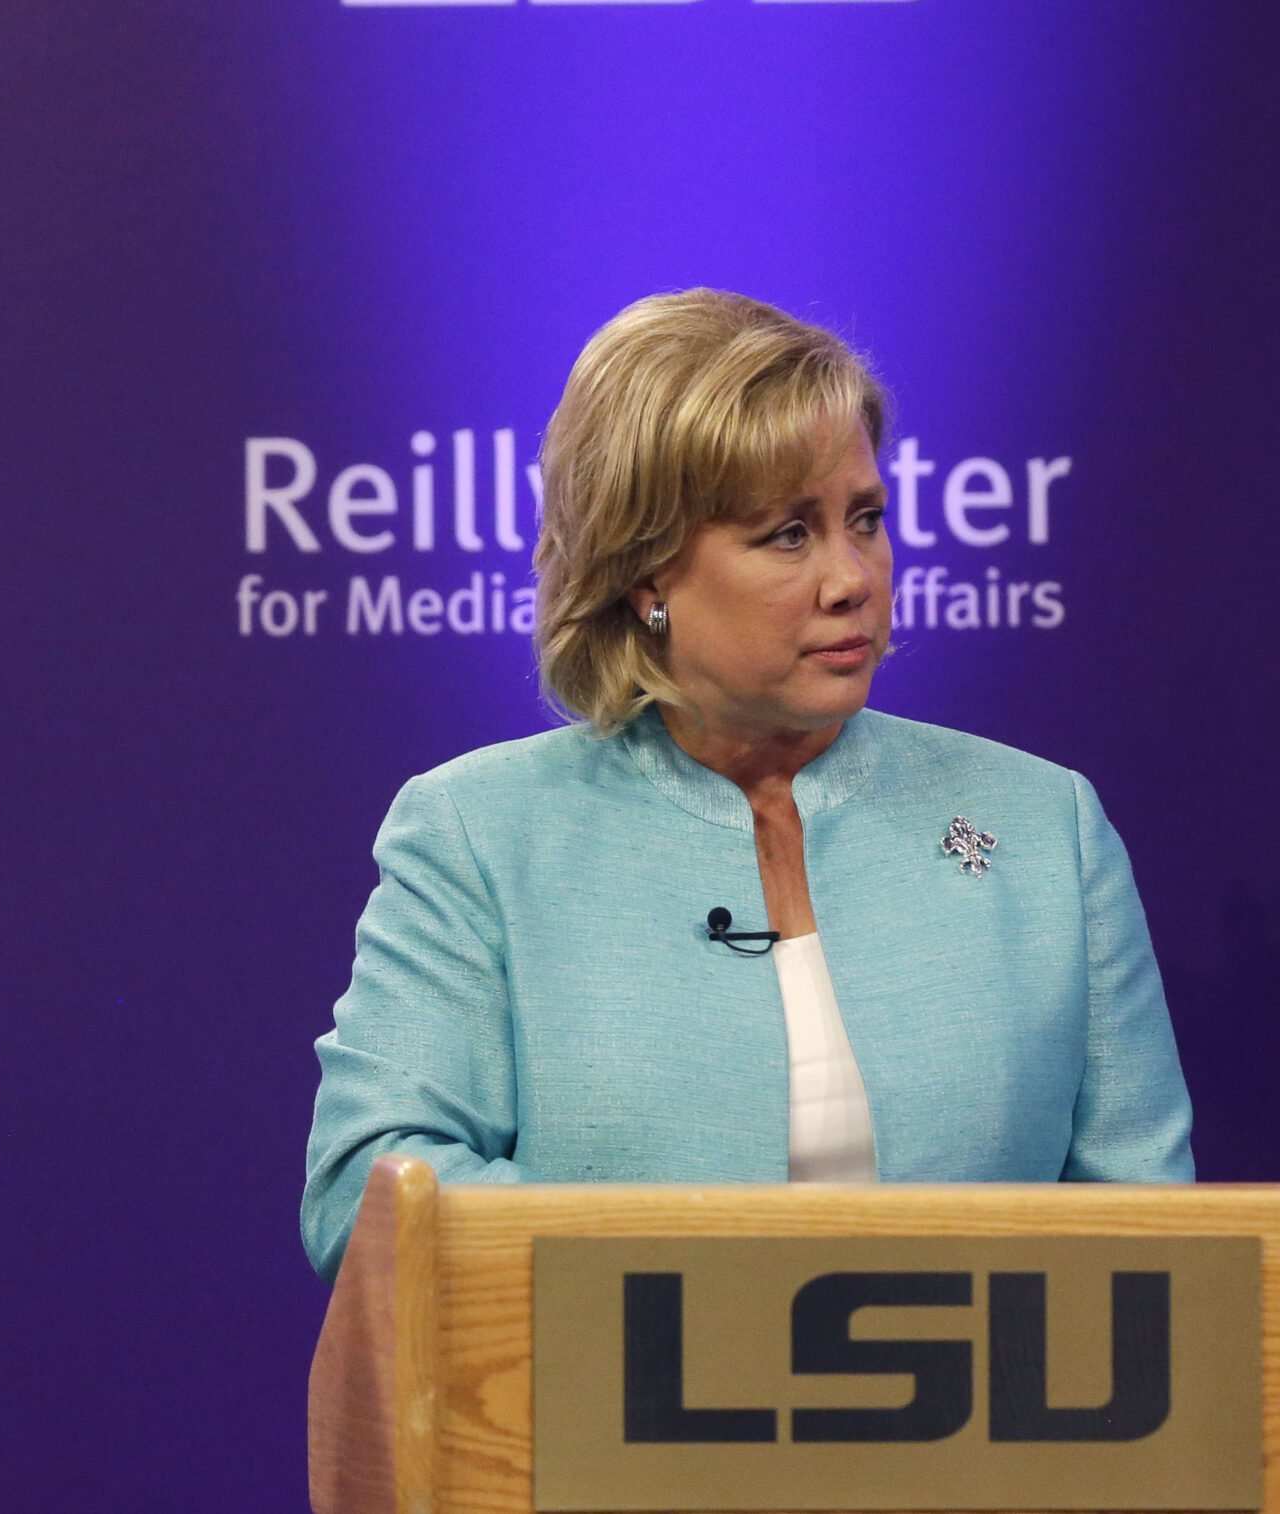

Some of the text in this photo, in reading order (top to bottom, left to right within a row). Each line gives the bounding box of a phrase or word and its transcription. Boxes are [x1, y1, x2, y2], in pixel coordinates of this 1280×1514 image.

[236, 566, 1066, 636] for Media ffairs
[623, 1271, 1171, 1442] LSU
